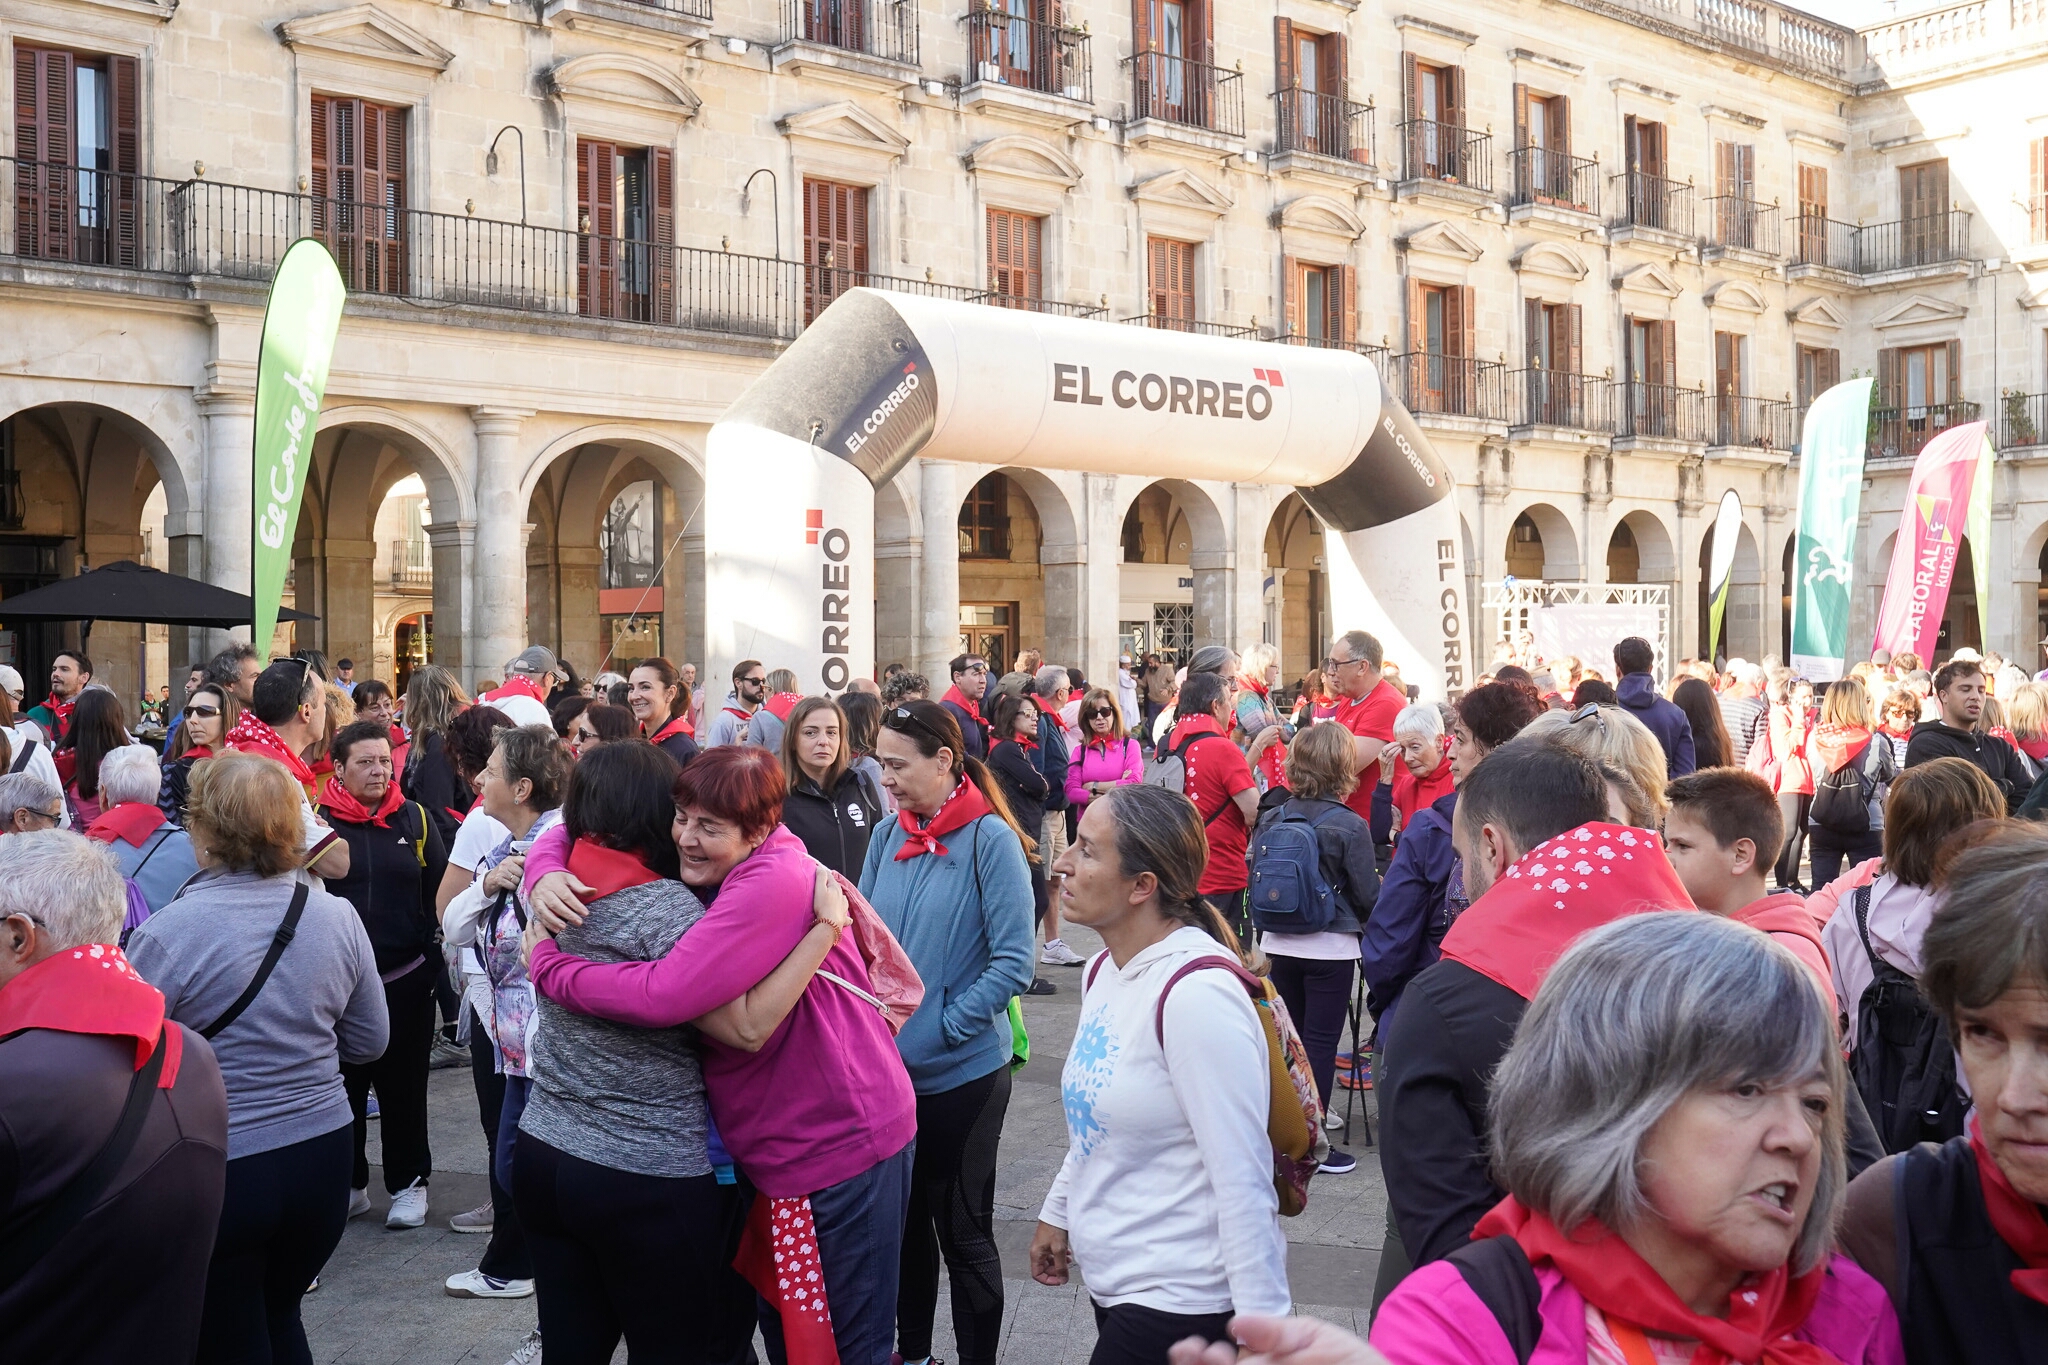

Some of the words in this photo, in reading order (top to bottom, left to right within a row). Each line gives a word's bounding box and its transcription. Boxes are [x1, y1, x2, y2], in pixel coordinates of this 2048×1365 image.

[844, 431, 869, 454] EL
[863, 373, 919, 434] CORREO
[1053, 362, 1104, 406] EL
[1111, 370, 1273, 421] CORREO
[270, 405, 306, 504] Corte
[1382, 416, 1396, 439] EL
[1395, 433, 1436, 488] CORREO
[259, 502, 288, 549] El
[1437, 539, 1456, 582] EL
[1903, 544, 1941, 642] LABORAL
[1935, 546, 1956, 588] kutxa
[821, 528, 850, 699] ORREO
